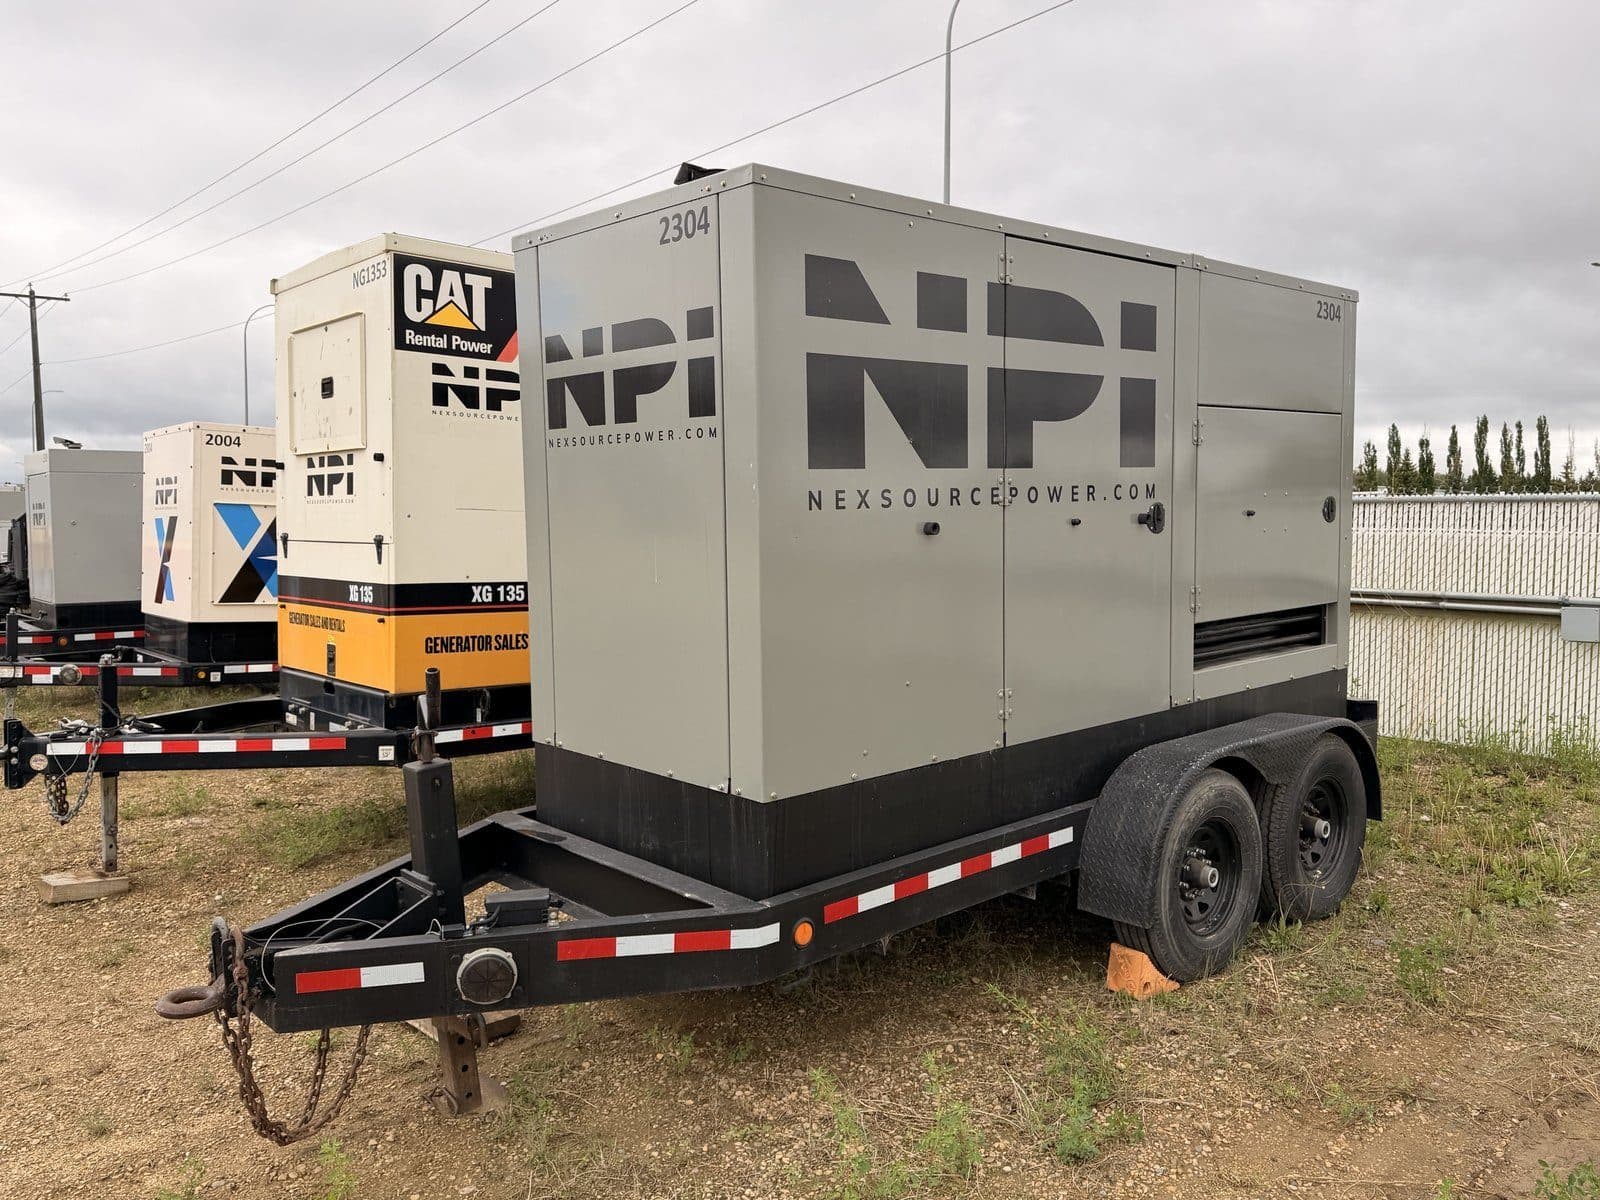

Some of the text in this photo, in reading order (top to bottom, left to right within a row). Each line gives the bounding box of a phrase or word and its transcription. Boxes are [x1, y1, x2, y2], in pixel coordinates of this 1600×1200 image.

[659, 205, 710, 246] 2304
[352, 260, 387, 290] NG1353
[403, 263, 493, 332] CAT
[1315, 299, 1342, 324] 2304
[405, 330, 493, 355] Rental Power
[432, 362, 521, 411] NP
[431, 410, 519, 422] NEXSOURCEPOWE
[205, 434, 242, 448] 2004
[547, 426, 718, 449] NEXSOURCEPOWER.COM
[221, 456, 276, 488] NP
[307, 453, 354, 496] NPI
[155, 476, 178, 505] NPI
[807, 482, 1157, 512] NEXSOURCEPOWER.COM
[349, 584, 373, 603] XG 135
[471, 584, 525, 603] XG 135
[288, 611, 346, 632] GENERATOR SALES AND RENTALS
[424, 633, 529, 654] GENERATOR SALES
